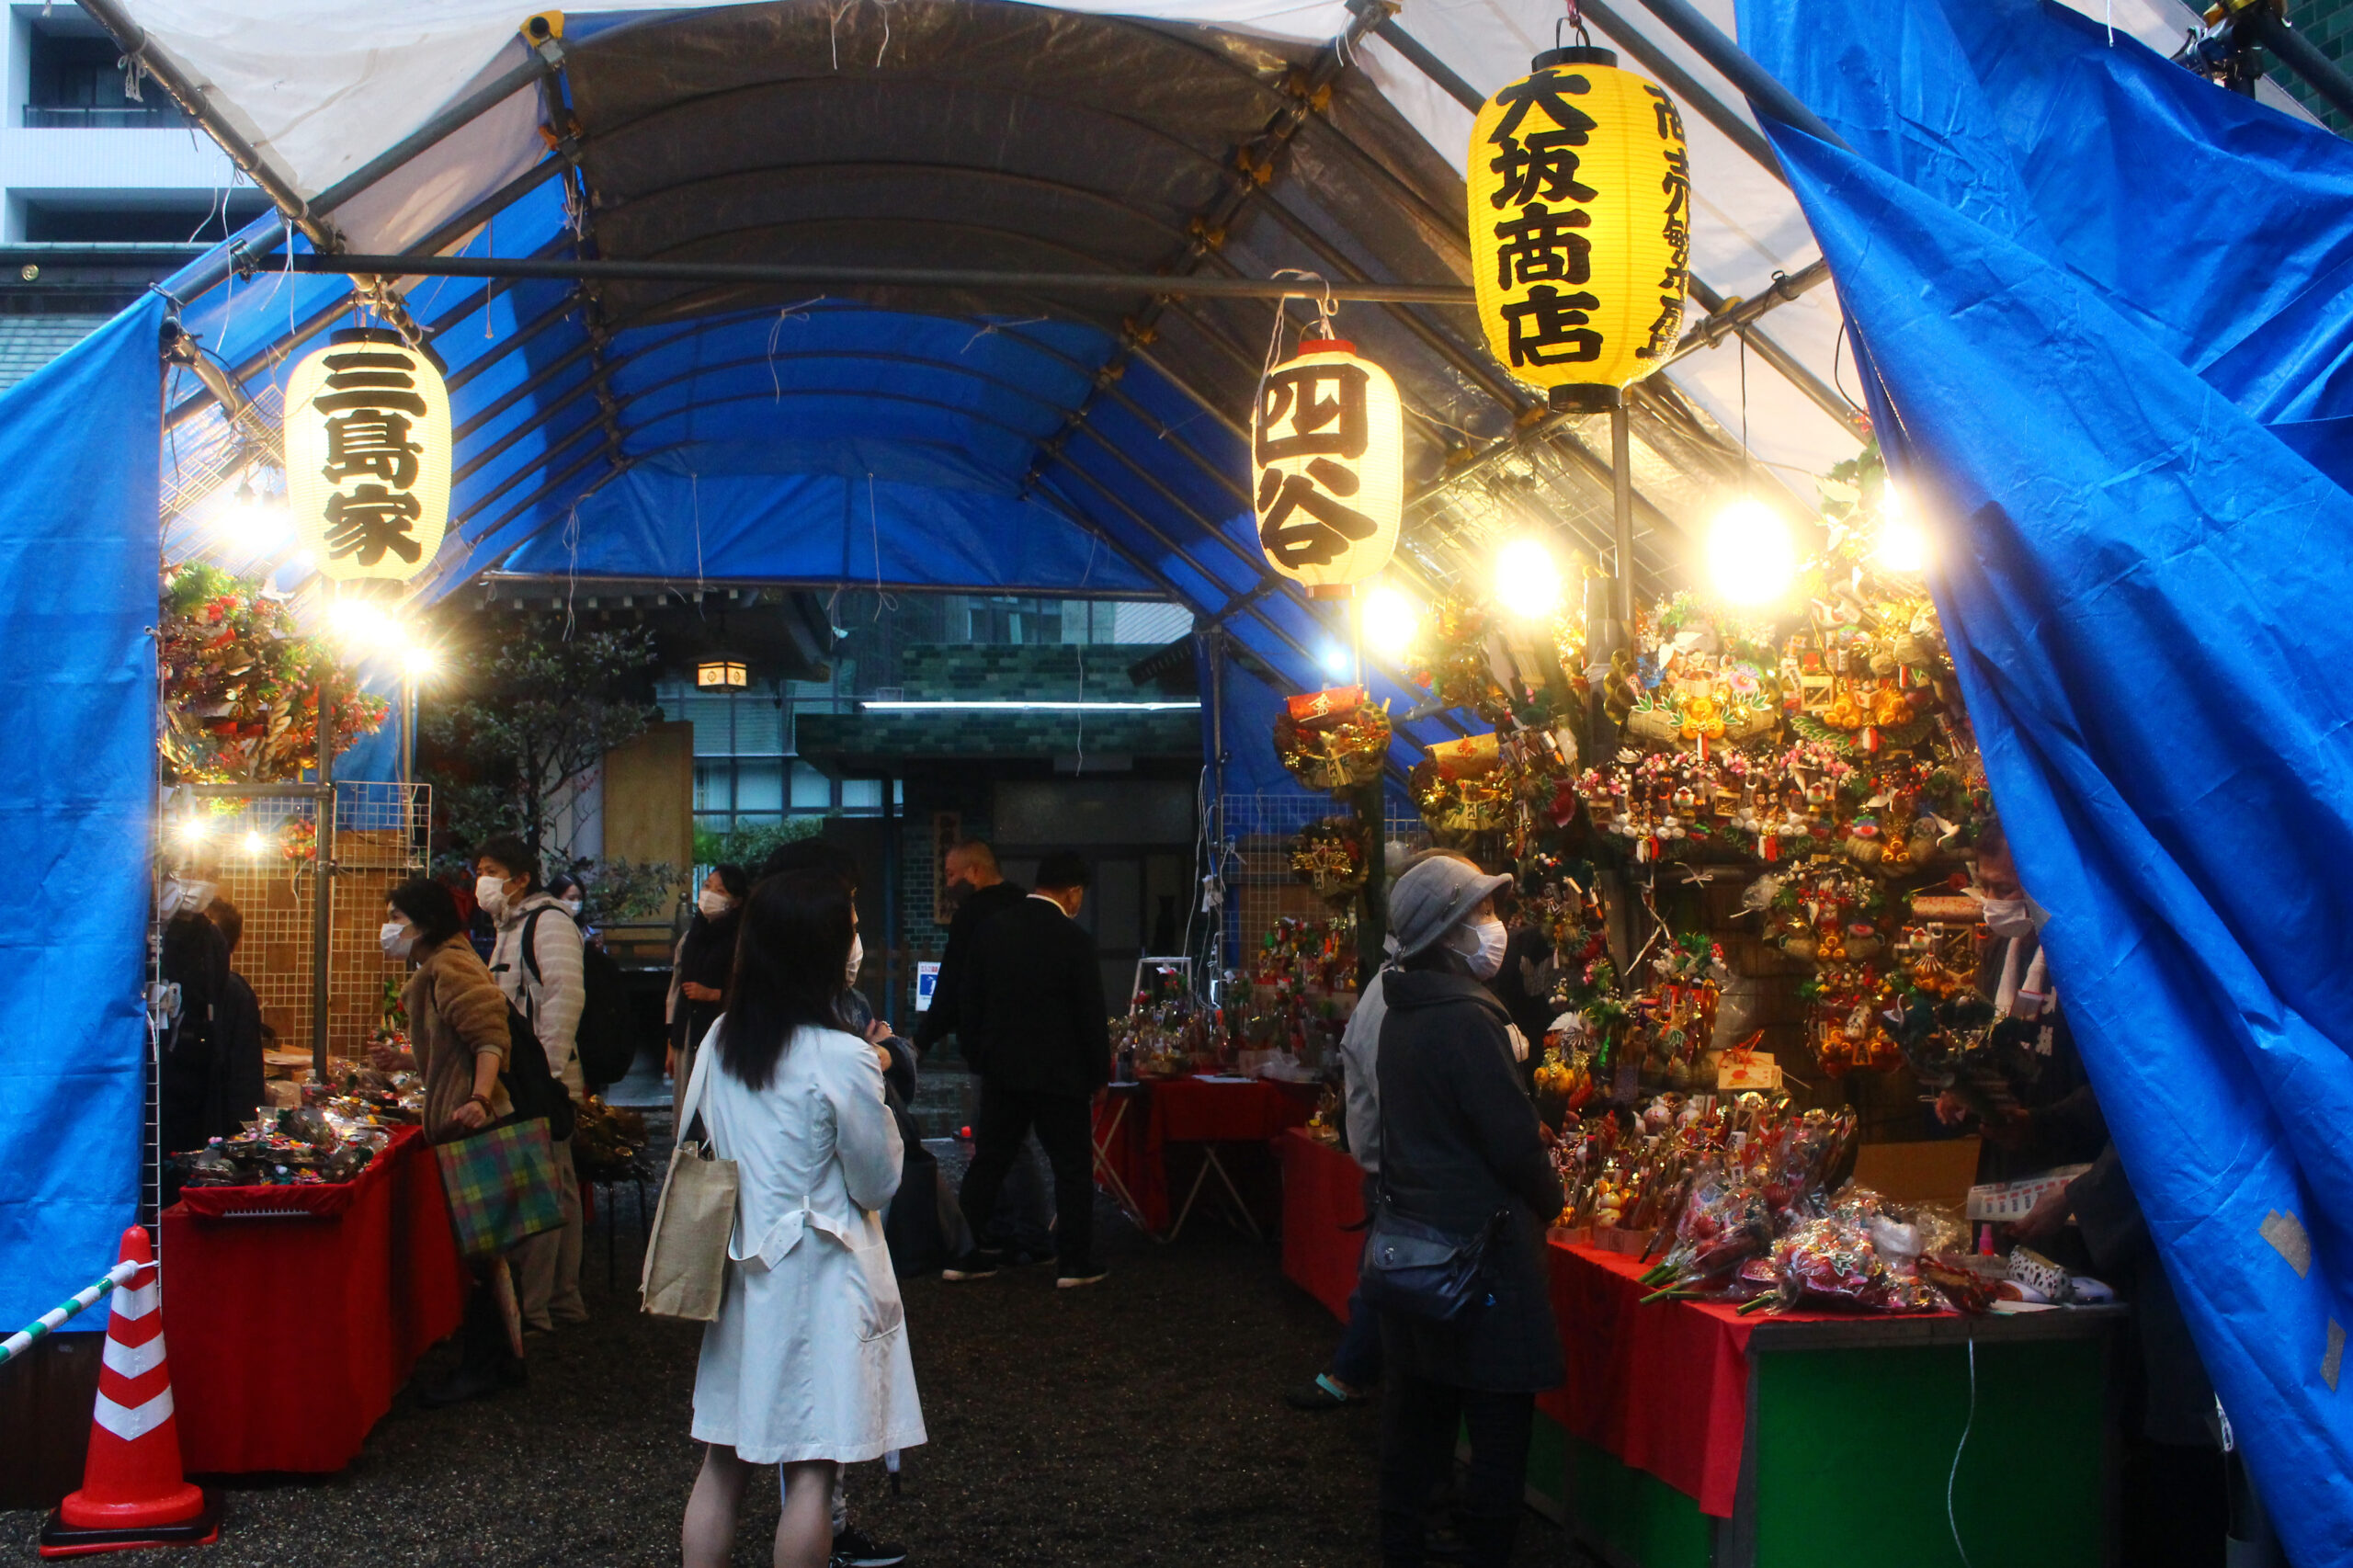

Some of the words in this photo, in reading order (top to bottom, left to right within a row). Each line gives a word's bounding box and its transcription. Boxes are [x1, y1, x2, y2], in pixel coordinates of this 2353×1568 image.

[1487, 69, 1603, 368] 大坂商店
[313, 351, 427, 566] 三島家
[1255, 362, 1378, 570] 四谷
